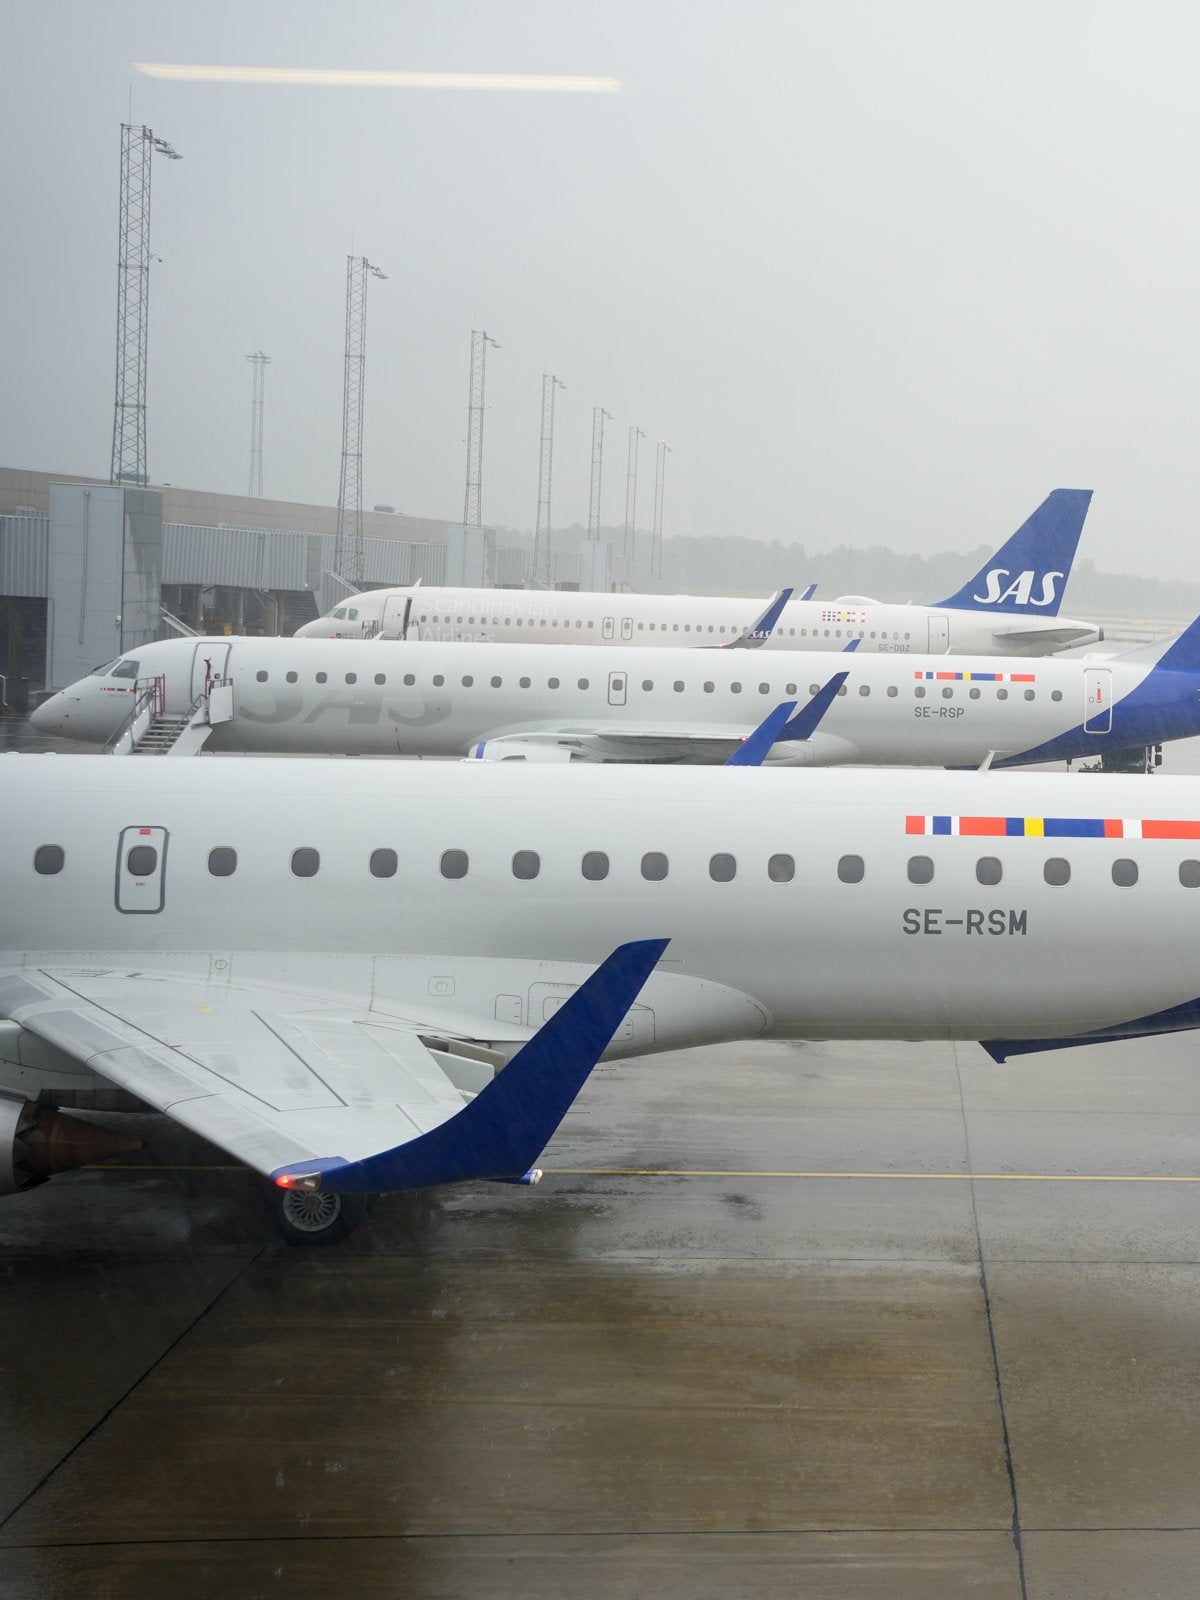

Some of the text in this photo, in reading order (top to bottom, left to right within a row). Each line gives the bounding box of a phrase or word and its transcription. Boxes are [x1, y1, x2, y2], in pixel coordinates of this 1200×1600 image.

[974, 569, 1064, 606] SAS
[418, 596, 557, 616] Scandinavian
[422, 626, 496, 643] Airlines
[752, 630, 770, 639] SAS
[914, 706, 965, 718] SE-RSP
[902, 908, 1028, 935] SE-RSM
